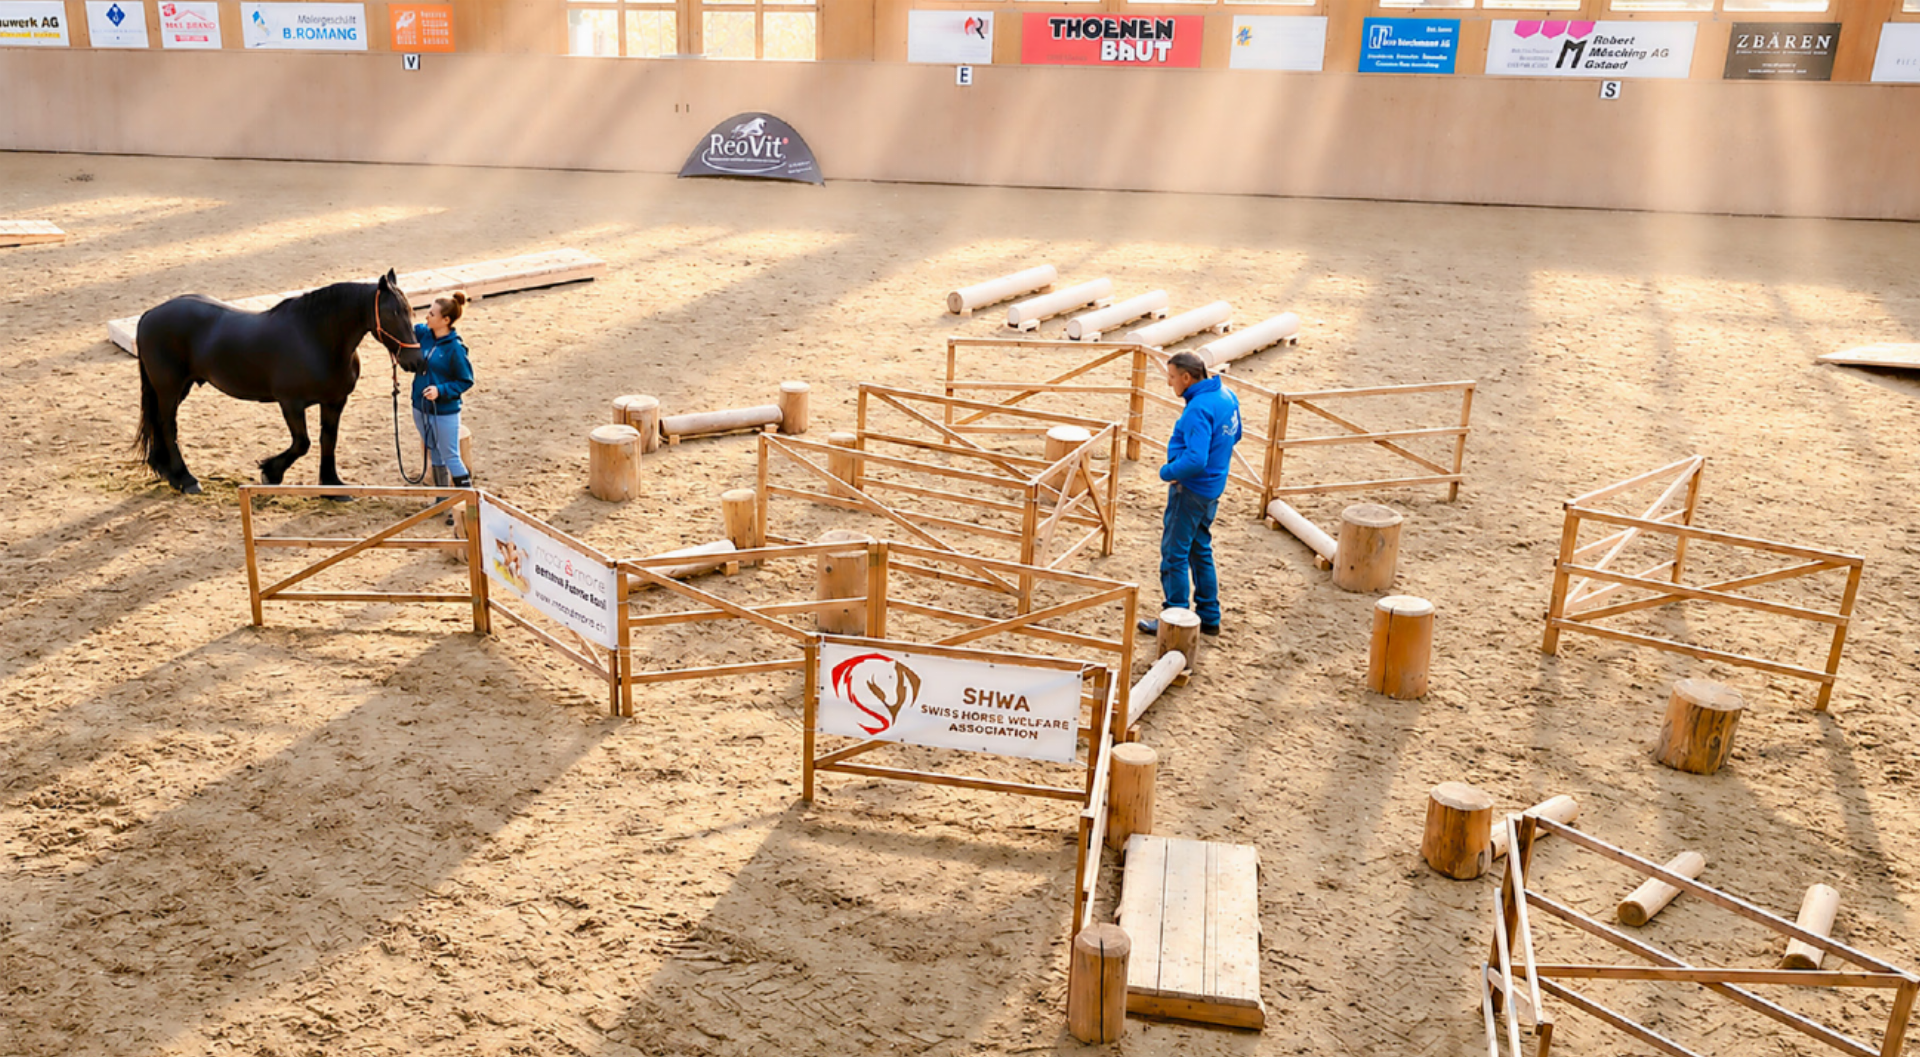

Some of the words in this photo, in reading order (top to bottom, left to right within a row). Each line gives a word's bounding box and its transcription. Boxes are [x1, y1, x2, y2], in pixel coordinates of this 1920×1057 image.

[0, 16, 38, 28] uwerk
[41, 16, 60, 28] AG
[1049, 17, 1175, 40] THOENEN
[283, 27, 357, 40] B.ROMANG
[1593, 35, 1635, 45] Robert
[1736, 32, 1832, 49] ZBÄREN
[1101, 40, 1172, 62] BAUT
[1588, 47, 1647, 60] Mösching
[1650, 48, 1669, 58] AG
[406, 55, 416, 68] V
[960, 67, 969, 83] E
[1604, 82, 1616, 97] S
[962, 687, 1030, 712] SHWA
[921, 704, 959, 719] SWISS
[961, 711, 1004, 724] HORSE
[1008, 715, 1069, 731] WELFARE
[948, 723, 1038, 740] ASSOCIATION
